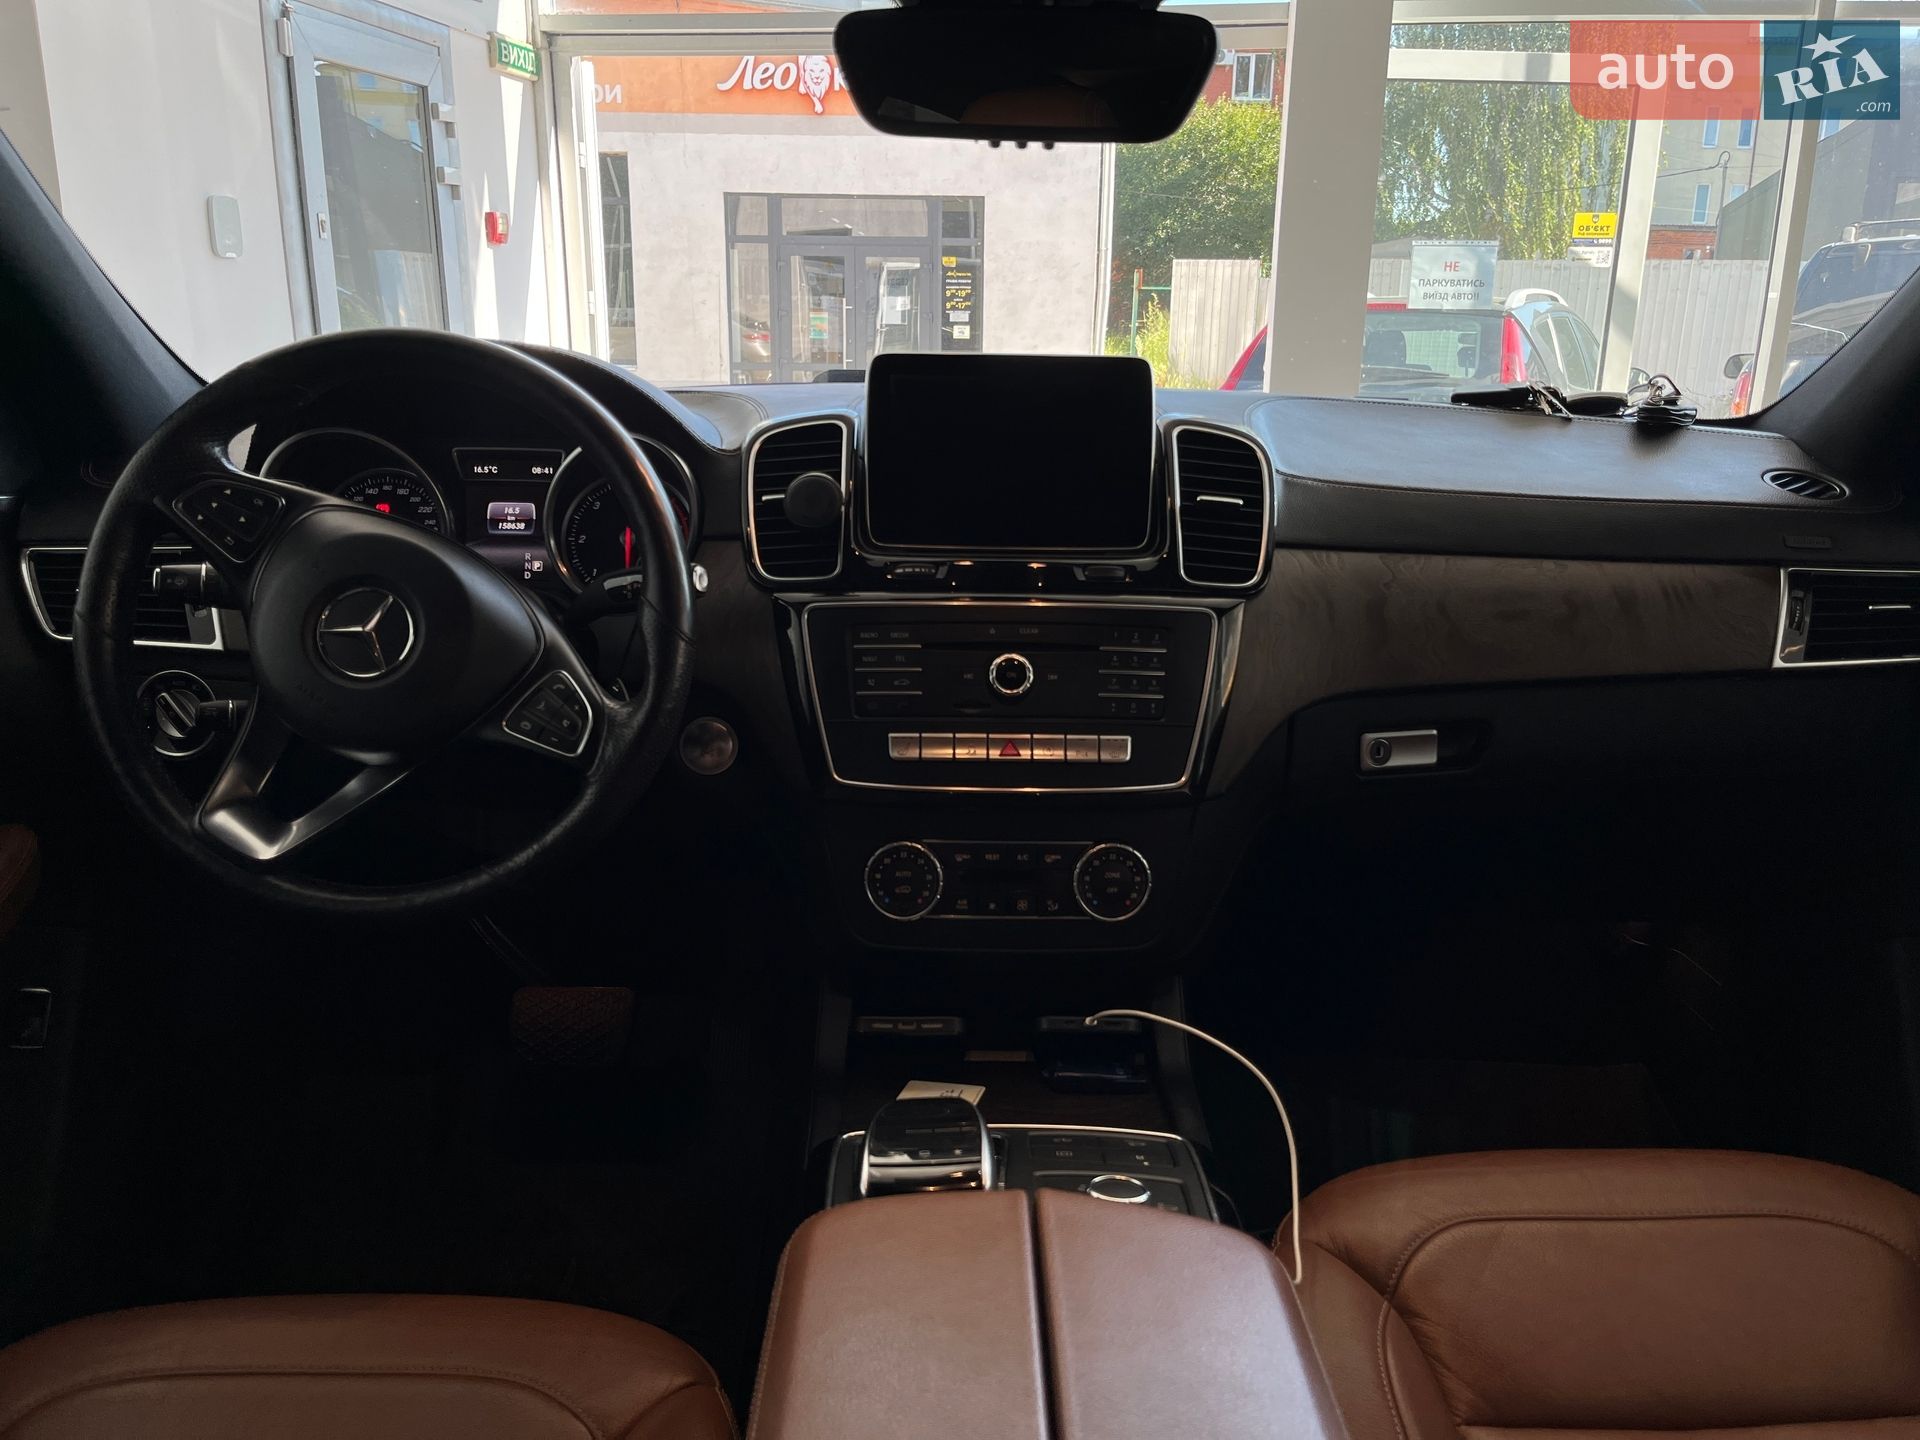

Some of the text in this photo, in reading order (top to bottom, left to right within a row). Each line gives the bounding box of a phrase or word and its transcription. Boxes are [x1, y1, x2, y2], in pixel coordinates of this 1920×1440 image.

[501, 43, 536, 73] ВИХІД
[716, 55, 798, 91] Лео
[1444, 261, 1461, 272] НЕ
[1418, 278, 1485, 288] ПАРКУВАТИСЬ
[1422, 291, 1449, 301] ВИЇЗД
[473, 465, 498, 474] 16.5°C
[531, 466, 554, 475] 08:41
[593, 501, 601, 510] 3
[578, 535, 587, 544] 2
[524, 562, 531, 570] N
[524, 571, 532, 579] D
